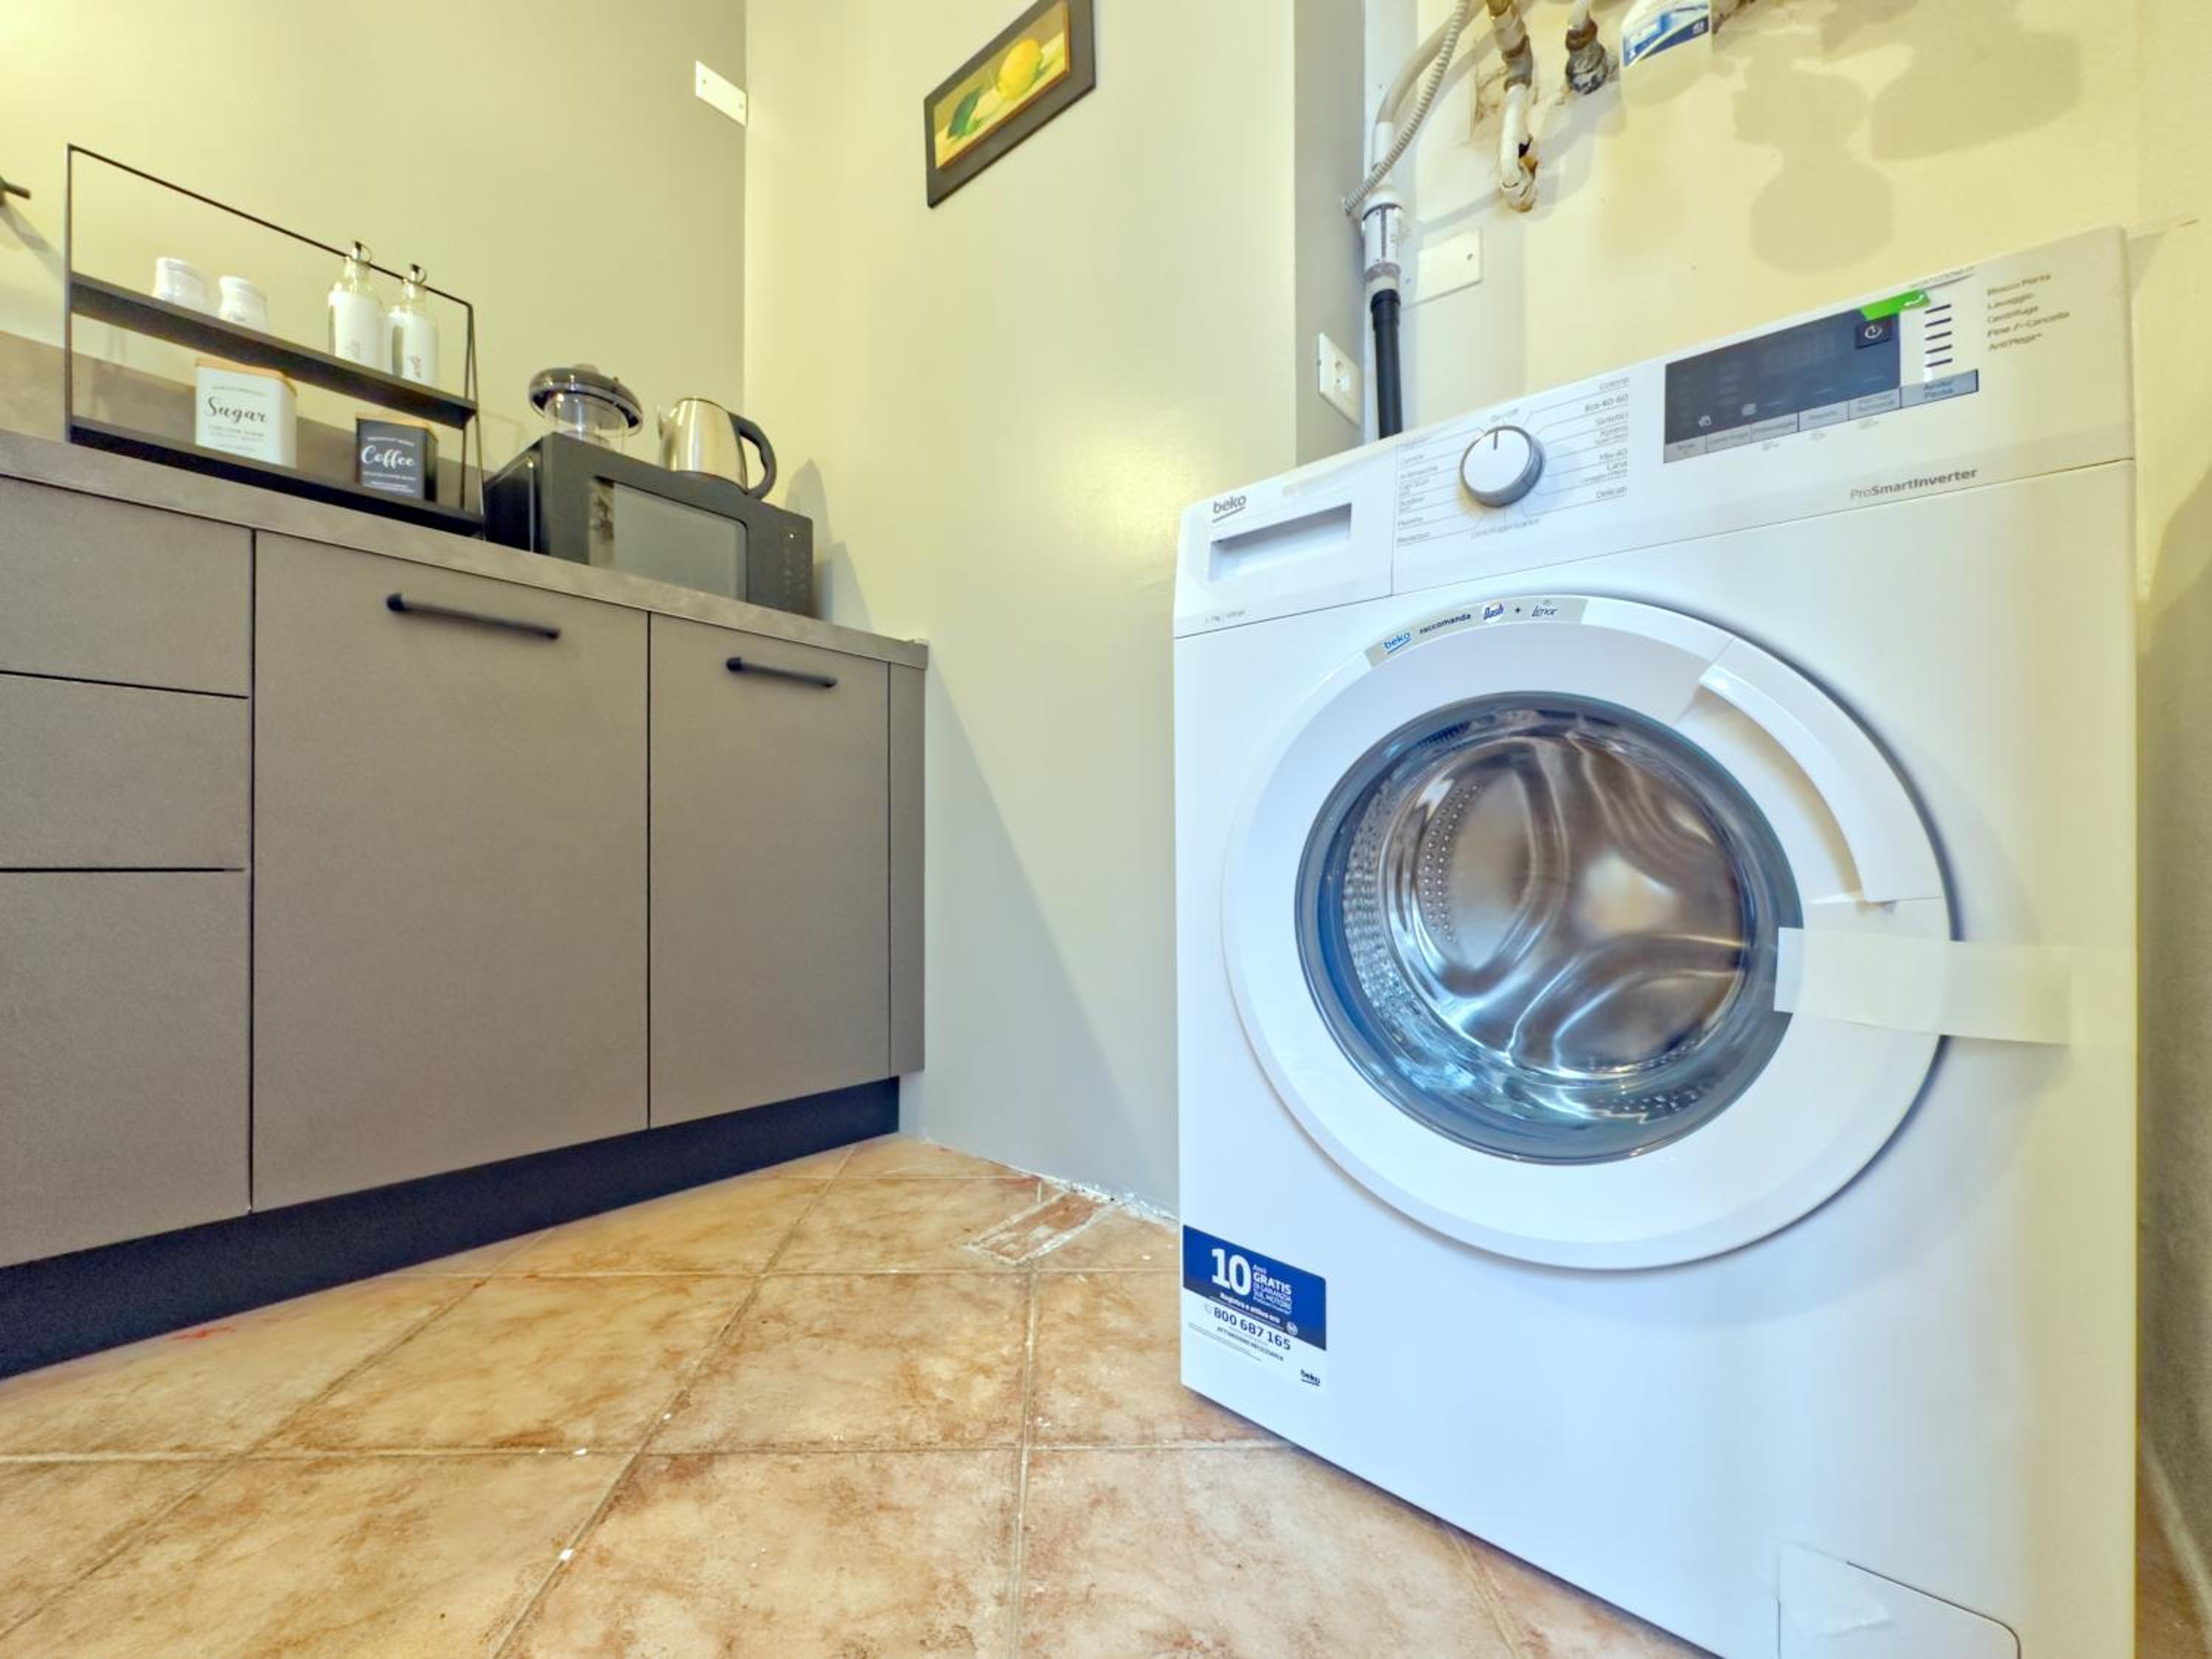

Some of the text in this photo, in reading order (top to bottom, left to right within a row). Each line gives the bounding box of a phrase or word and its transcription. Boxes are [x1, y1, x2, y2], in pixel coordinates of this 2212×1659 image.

[207, 397, 266, 424] Sugar
[361, 444, 415, 470] Coffee
[1850, 468, 1978, 501] ProSmartInverter
[1213, 495, 1247, 515] beko
[1383, 630, 1412, 651] beko
[1419, 613, 1472, 635] raccomanda
[1211, 1248, 1251, 1296] 10
[1253, 1272, 1292, 1295] GRATIS
[1214, 1307, 1237, 1326] 800
[1239, 1318, 1265, 1338] 687
[1267, 1330, 1291, 1351] 165
